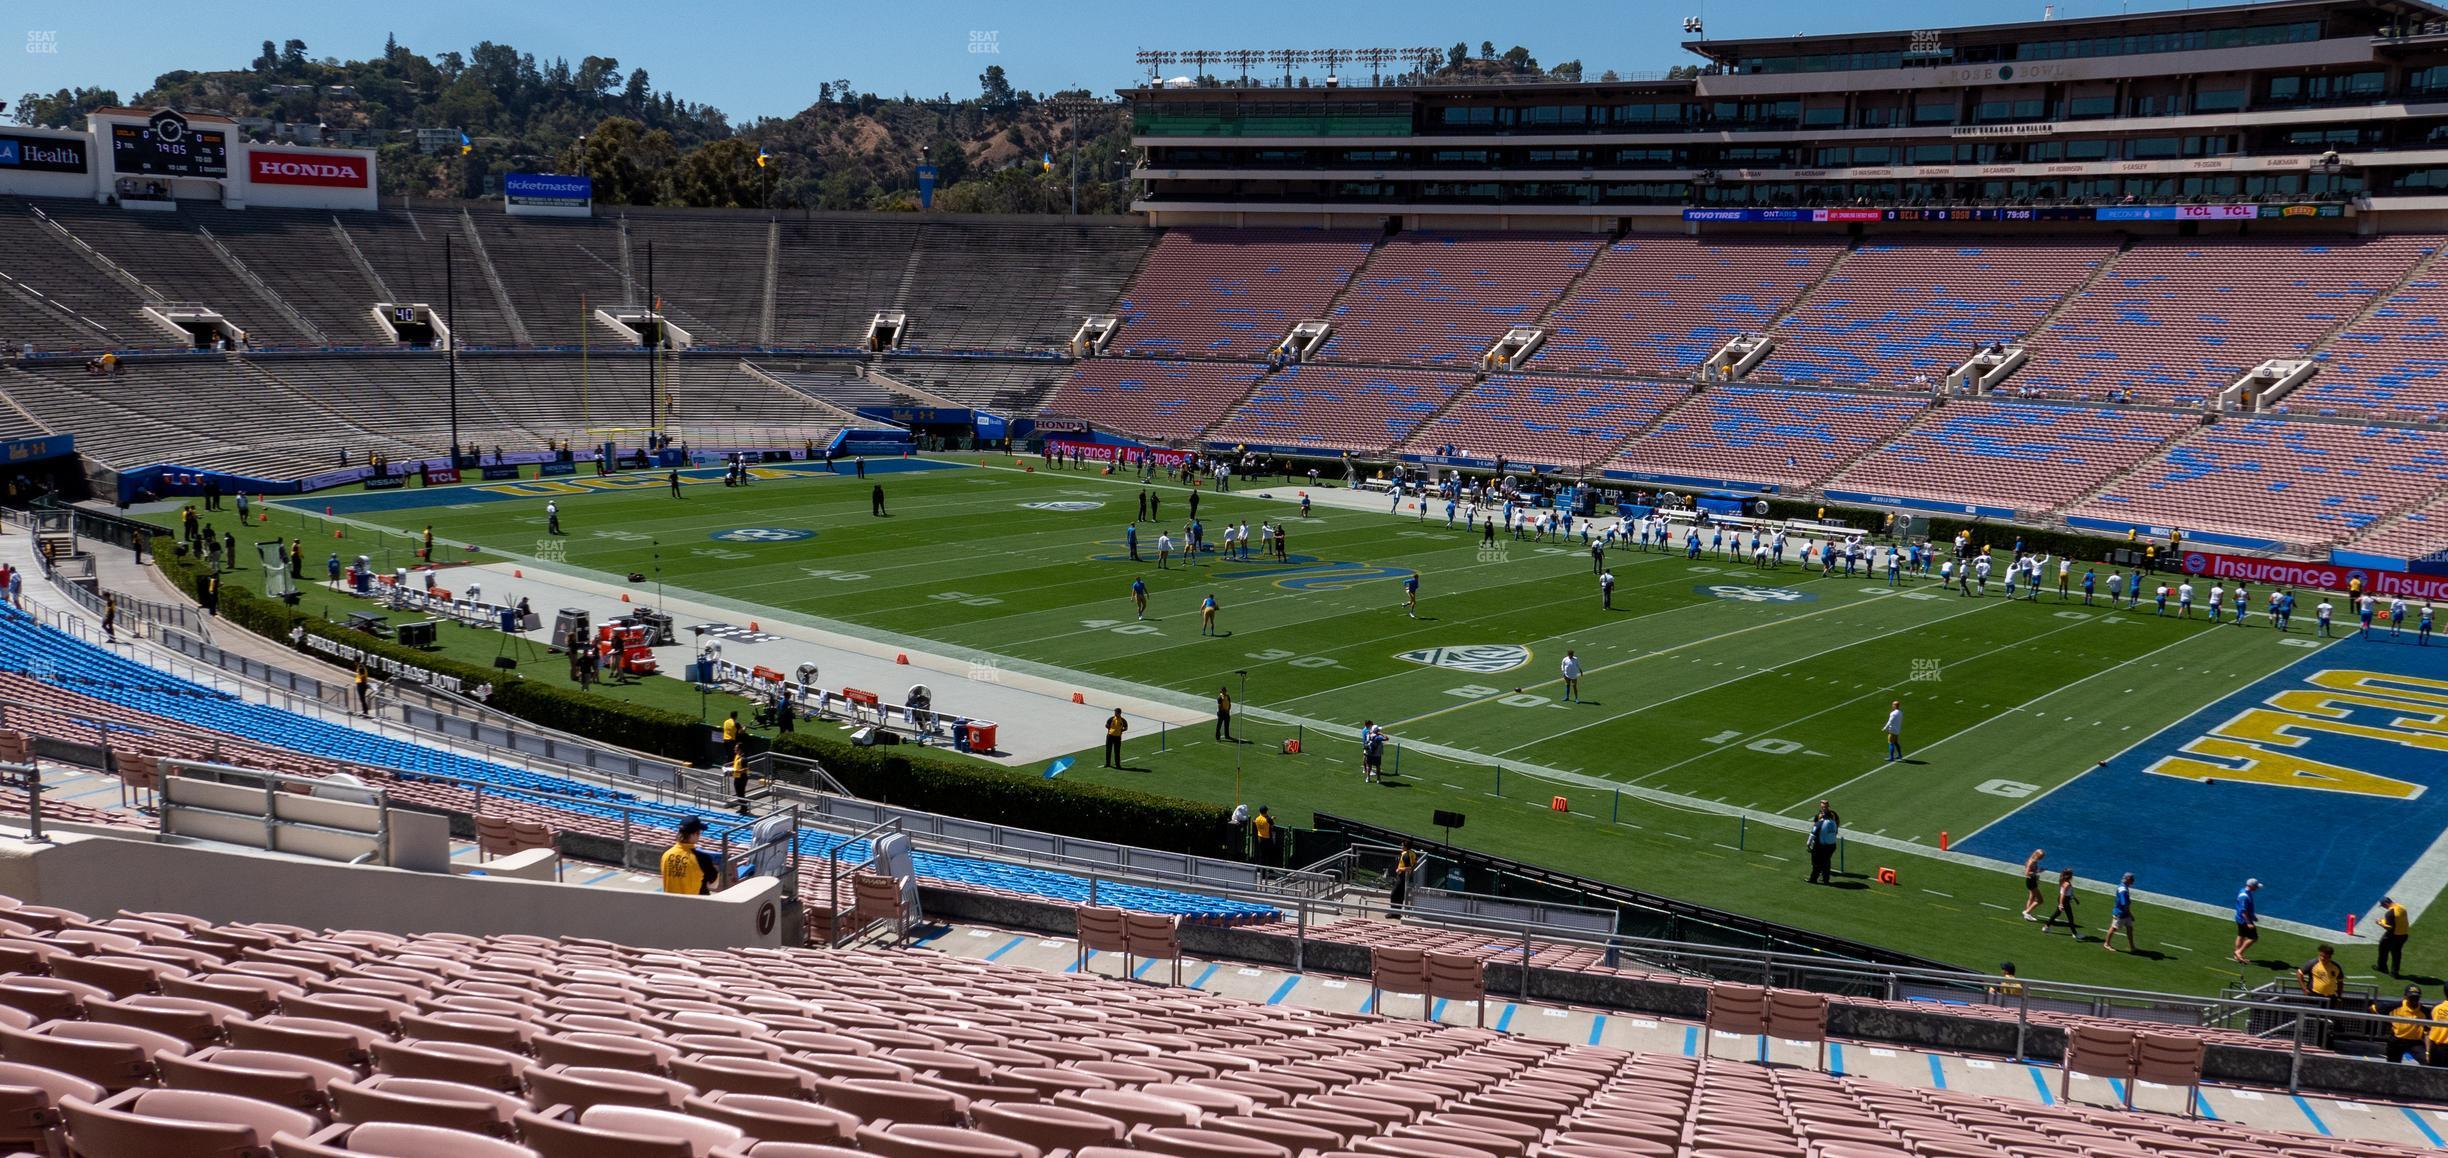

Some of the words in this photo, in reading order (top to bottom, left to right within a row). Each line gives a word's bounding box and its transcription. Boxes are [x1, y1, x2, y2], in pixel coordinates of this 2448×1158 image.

[1951, 68, 1993, 80] ROSE
[2020, 65, 2064, 78] BOWL
[24, 145, 79, 164] Health
[260, 162, 360, 178] HONDA
[508, 180, 585, 192] ticketmaster
[2184, 207, 2211, 216] TCL
[2223, 207, 2251, 215] TCL
[396, 307, 415, 322] 40
[1035, 421, 1085, 431] HONDA
[429, 472, 456, 483] TCL
[2214, 555, 2337, 588] Insurance
[1245, 648, 1339, 668] 30
[366, 654, 379, 668] AT
[380, 657, 402, 673] THE
[403, 664, 430, 683] ROSE
[432, 672, 463, 694] BOWL
[1443, 684, 1552, 708] 20
[972, 730, 980, 743] G
[1702, 730, 1804, 754] 10
[2142, 669, 2448, 800] UCLA
[1288, 739, 1300, 753] 20
[1974, 778, 2042, 798] G
[1553, 797, 1567, 812] 10
[668, 854, 689, 864] CSC
[1881, 870, 1894, 884] G
[762, 908, 770, 928] 7
